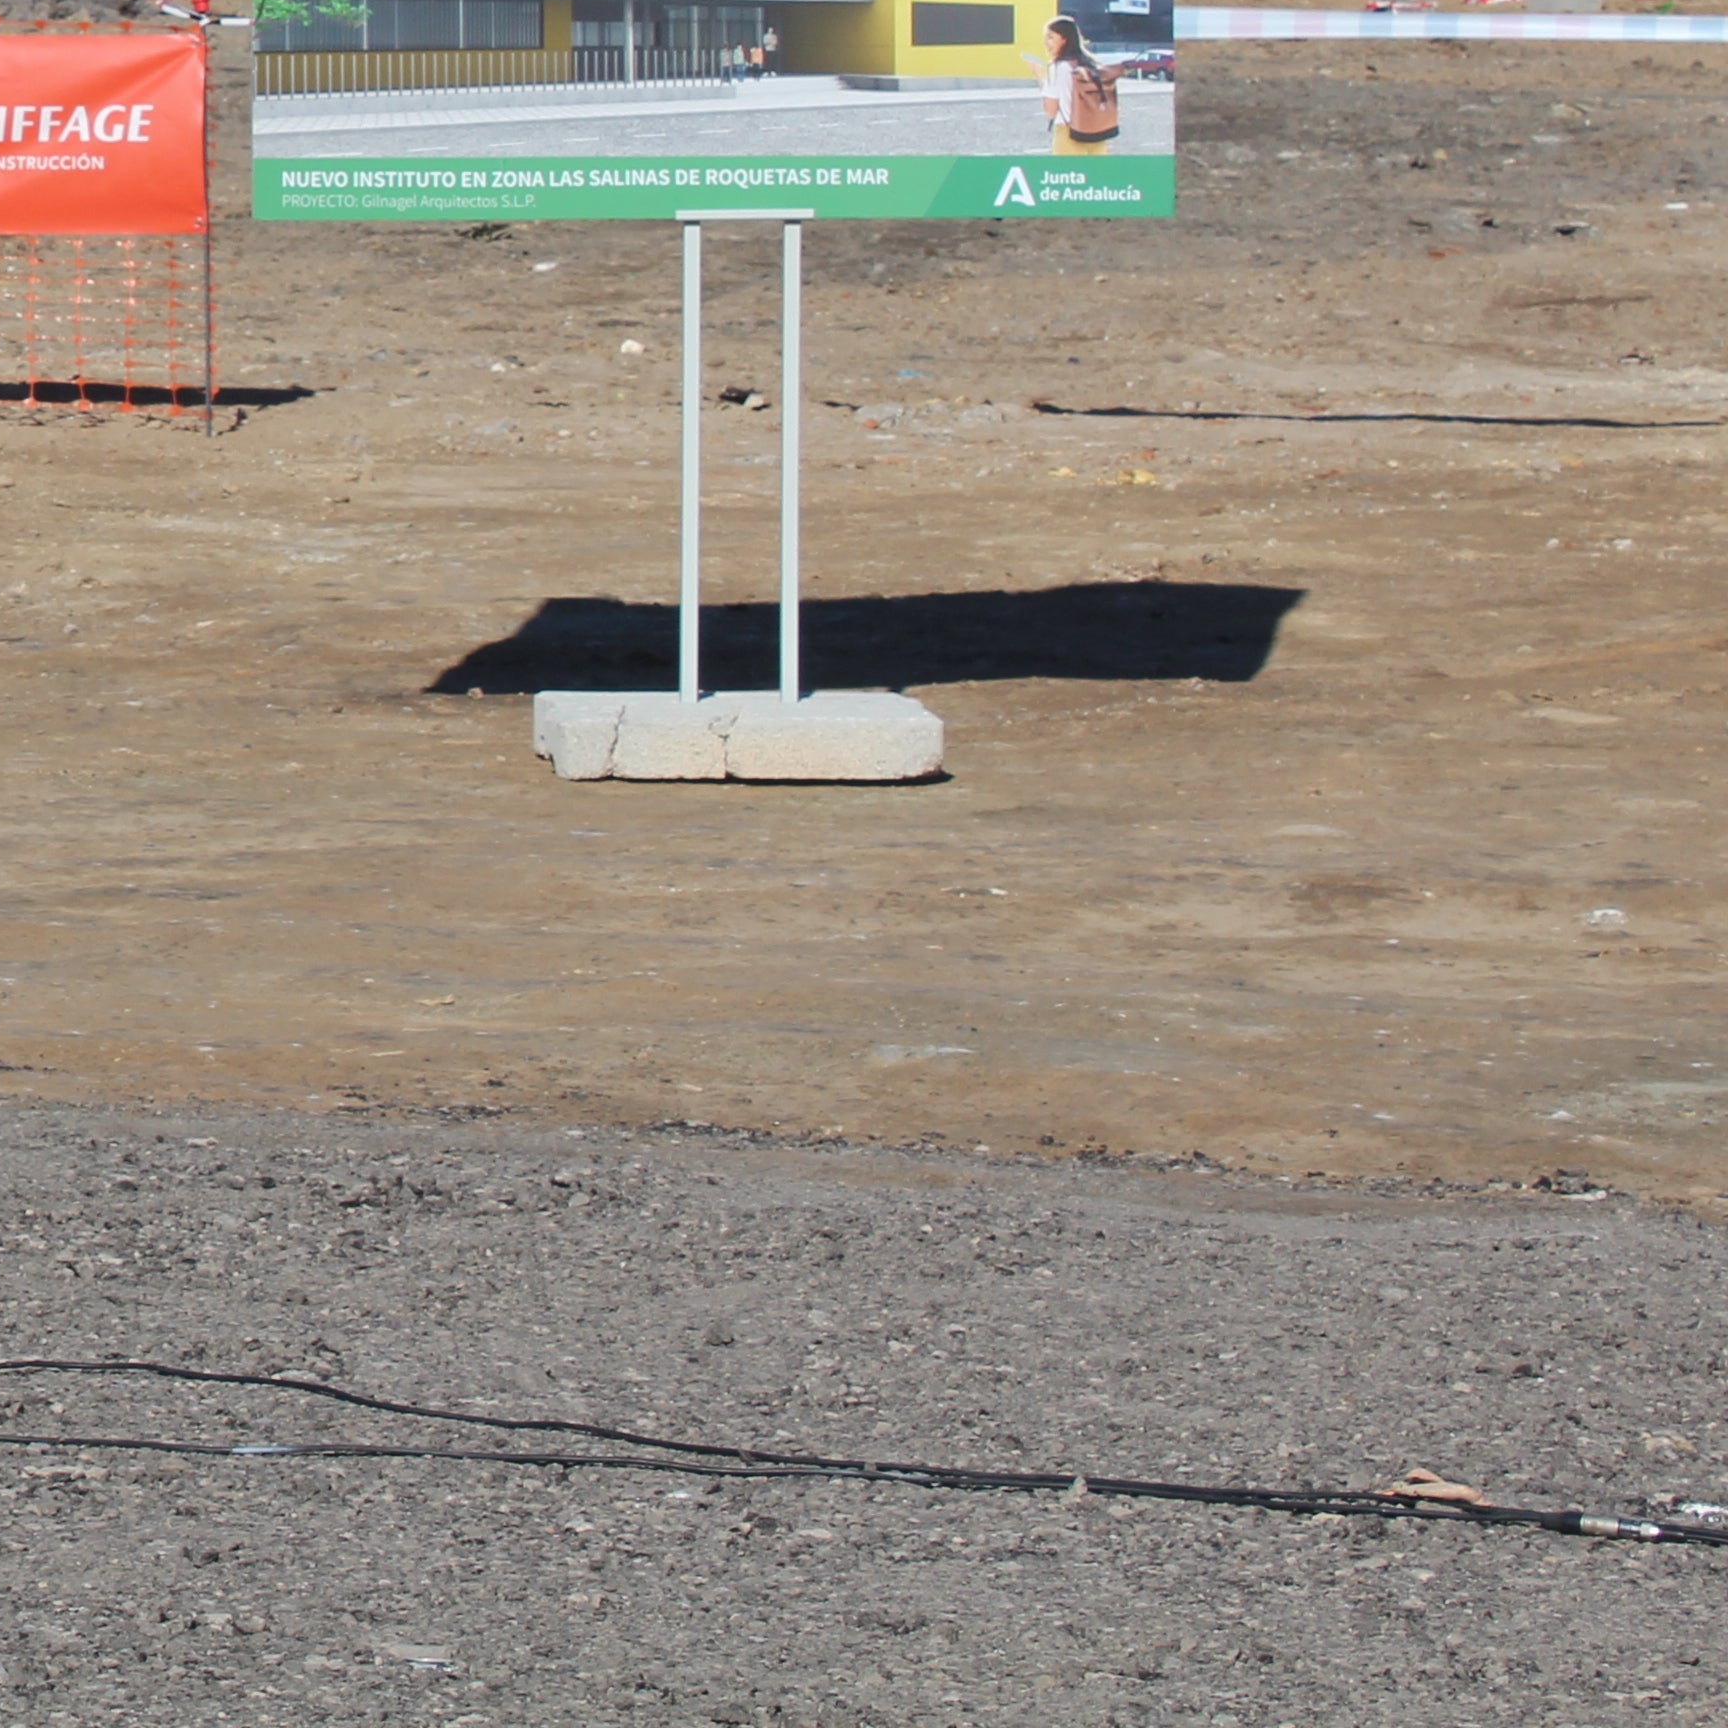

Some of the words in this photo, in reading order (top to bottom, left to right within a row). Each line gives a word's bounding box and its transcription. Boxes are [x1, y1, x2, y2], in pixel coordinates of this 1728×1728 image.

[282, 170, 349, 188] NUEVO
[353, 170, 457, 188] INSTITUTO
[461, 170, 487, 188] EN
[491, 170, 546, 188] ZONA
[549, 169, 586, 188] LAS
[589, 168, 671, 187] SALINAS
[675, 168, 701, 186] DE
[705, 167, 812, 189] ROQUETAS
[816, 168, 842, 186] DE
[846, 167, 889, 185] MAR
[1040, 171, 1086, 184] Junta
[1040, 186, 1060, 201] de
[1062, 185, 1141, 201] Andalucía
[281, 193, 359, 209] PROYECTO:
[361, 193, 417, 212] Gilnagel
[419, 193, 498, 212] Arquitectos
[500, 193, 537, 209] S.L.P.
